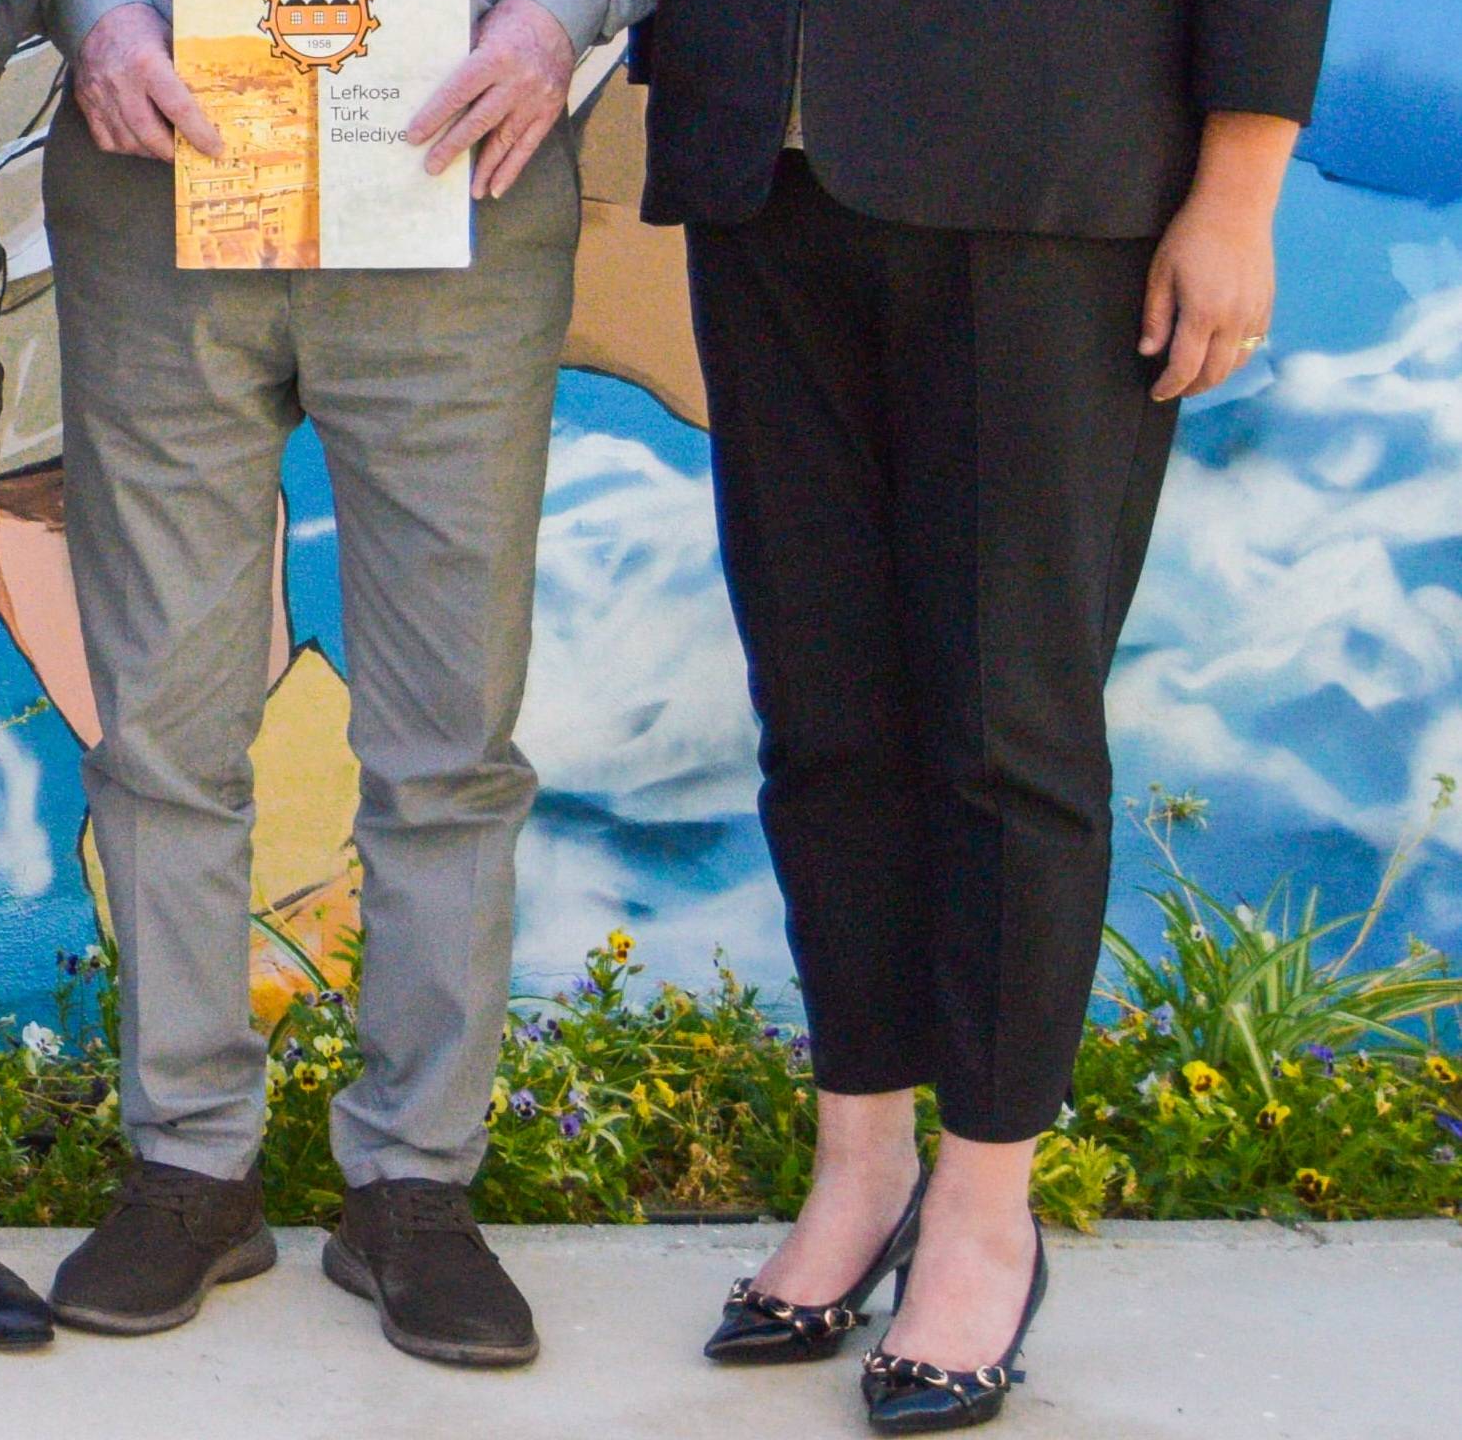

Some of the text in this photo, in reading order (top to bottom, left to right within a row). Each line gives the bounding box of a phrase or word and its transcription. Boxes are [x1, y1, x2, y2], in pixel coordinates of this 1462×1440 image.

[307, 39, 332, 49] 1958
[330, 84, 401, 101] Lefkoşa
[330, 106, 370, 121] Türk
[331, 127, 408, 145] Belediye
